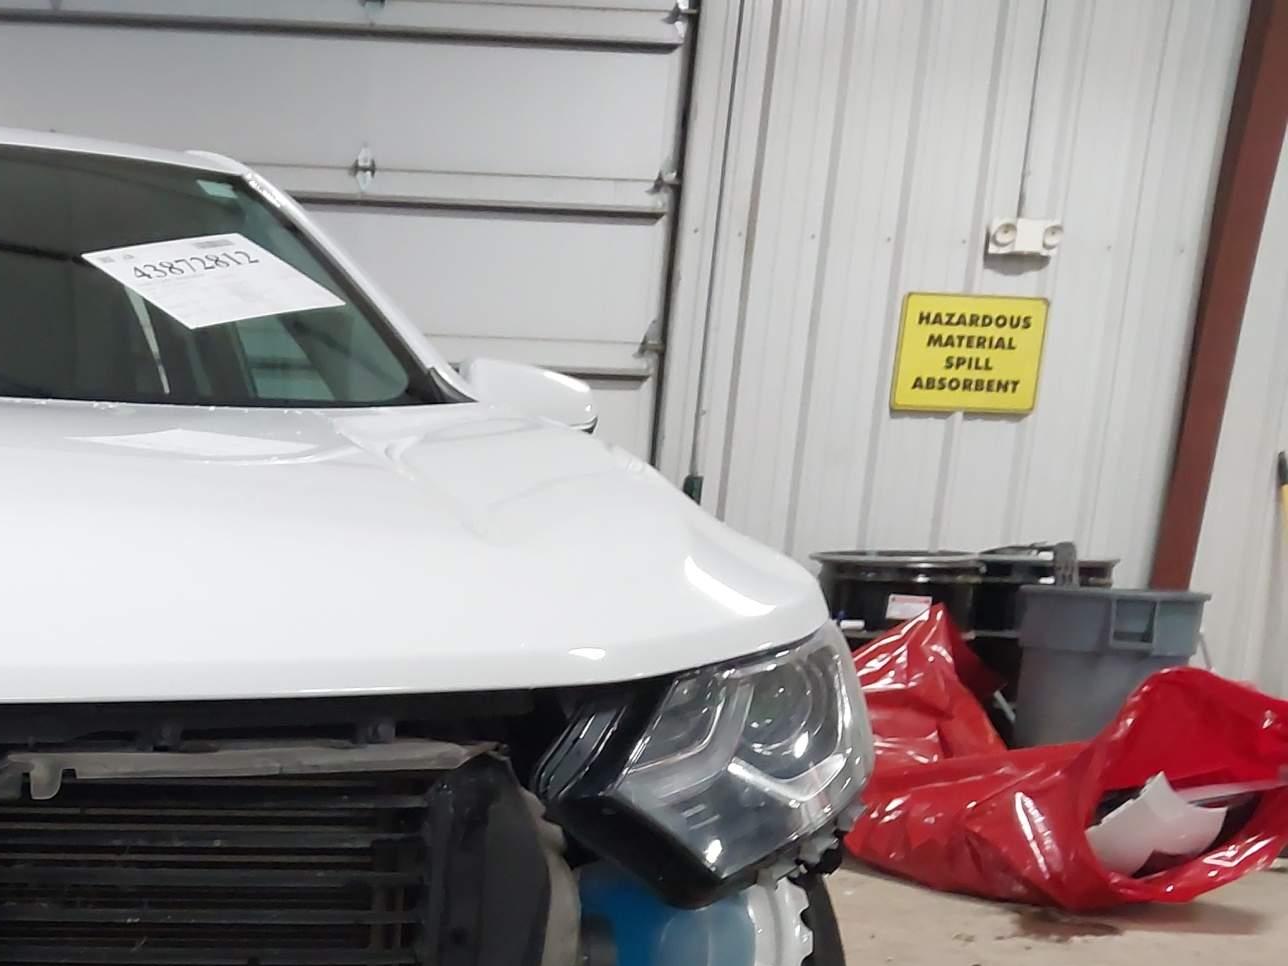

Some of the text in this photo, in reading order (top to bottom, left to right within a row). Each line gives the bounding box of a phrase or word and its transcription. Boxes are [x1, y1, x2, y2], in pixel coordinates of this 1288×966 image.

[133, 250, 260, 280] 43872812
[918, 311, 1032, 329] HAZARDOUS
[926, 333, 1017, 350] MATERIAL
[943, 355, 993, 371] SPILL
[911, 376, 1021, 394] ABSORBENT
